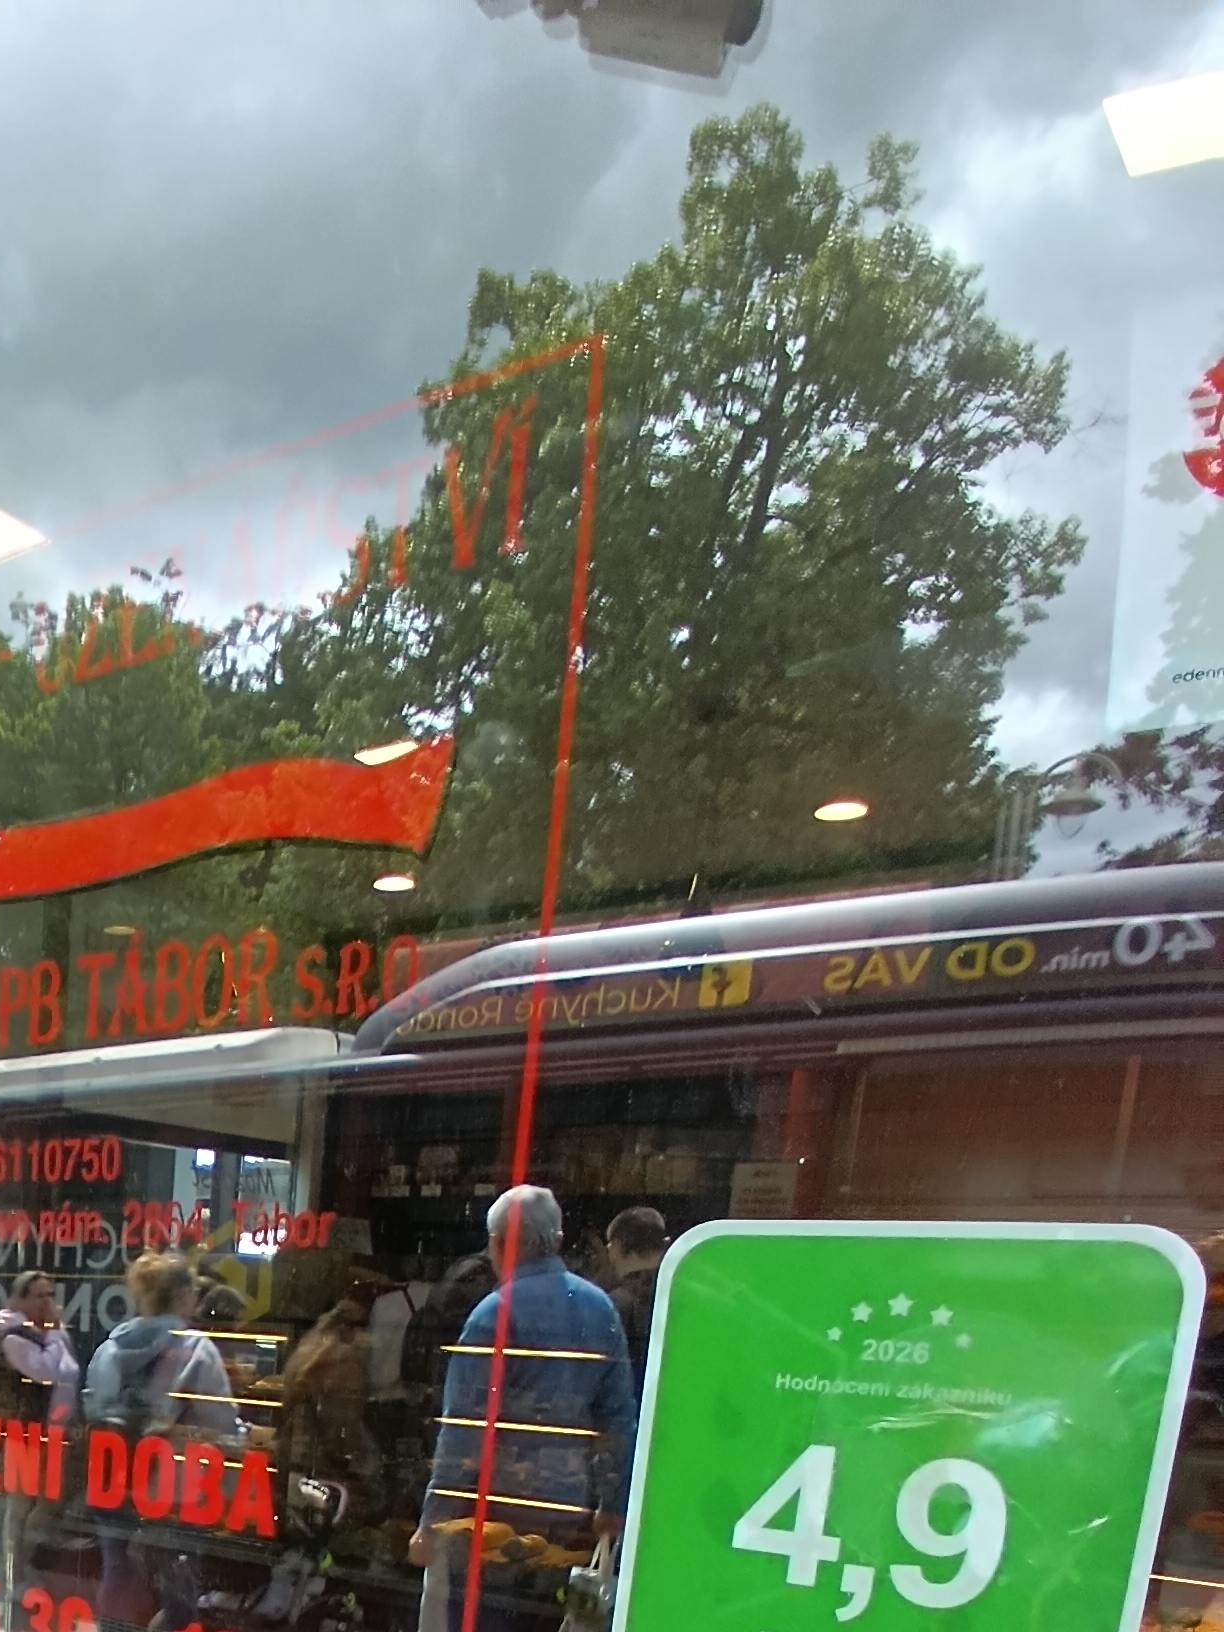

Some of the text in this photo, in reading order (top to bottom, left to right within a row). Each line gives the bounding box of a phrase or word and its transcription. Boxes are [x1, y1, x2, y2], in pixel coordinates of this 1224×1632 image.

[77, 927, 279, 1041] TÁBOR
[231, 1198, 336, 1249] Tábor
[860, 1338, 930, 1365] 2026
[86, 1429, 277, 1538] DOBA
[731, 1443, 1008, 1623] 4,9
